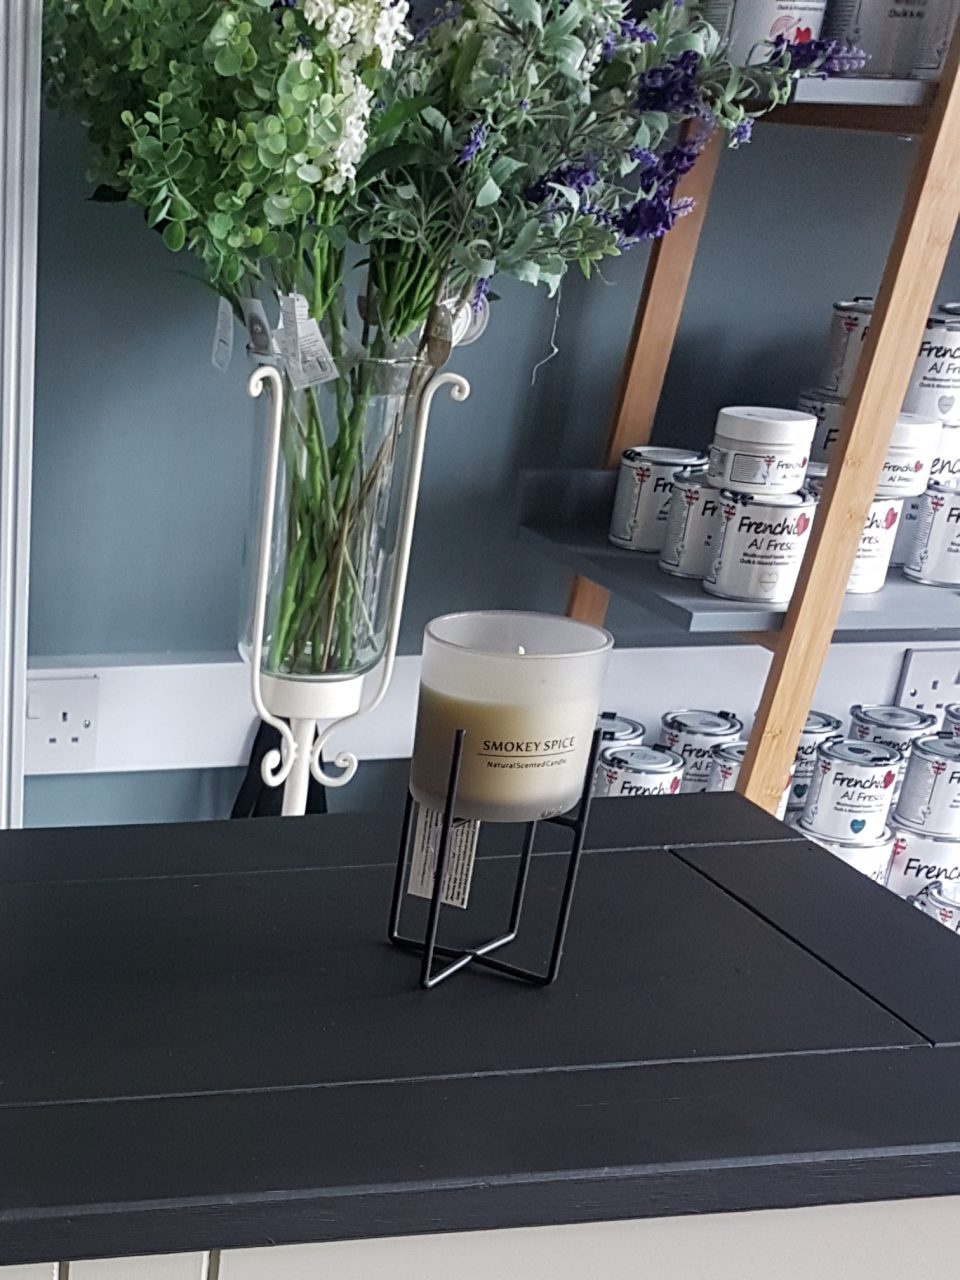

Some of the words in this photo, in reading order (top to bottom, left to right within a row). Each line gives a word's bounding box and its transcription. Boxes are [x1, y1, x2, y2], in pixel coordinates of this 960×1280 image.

[748, 538, 765, 550] Al
[483, 740, 541, 753] SMOKEY
[543, 736, 575, 752] SPICE
[487, 761, 516, 769] Natural
[516, 761, 545, 769] Scented
[840, 791, 855, 801] Al
